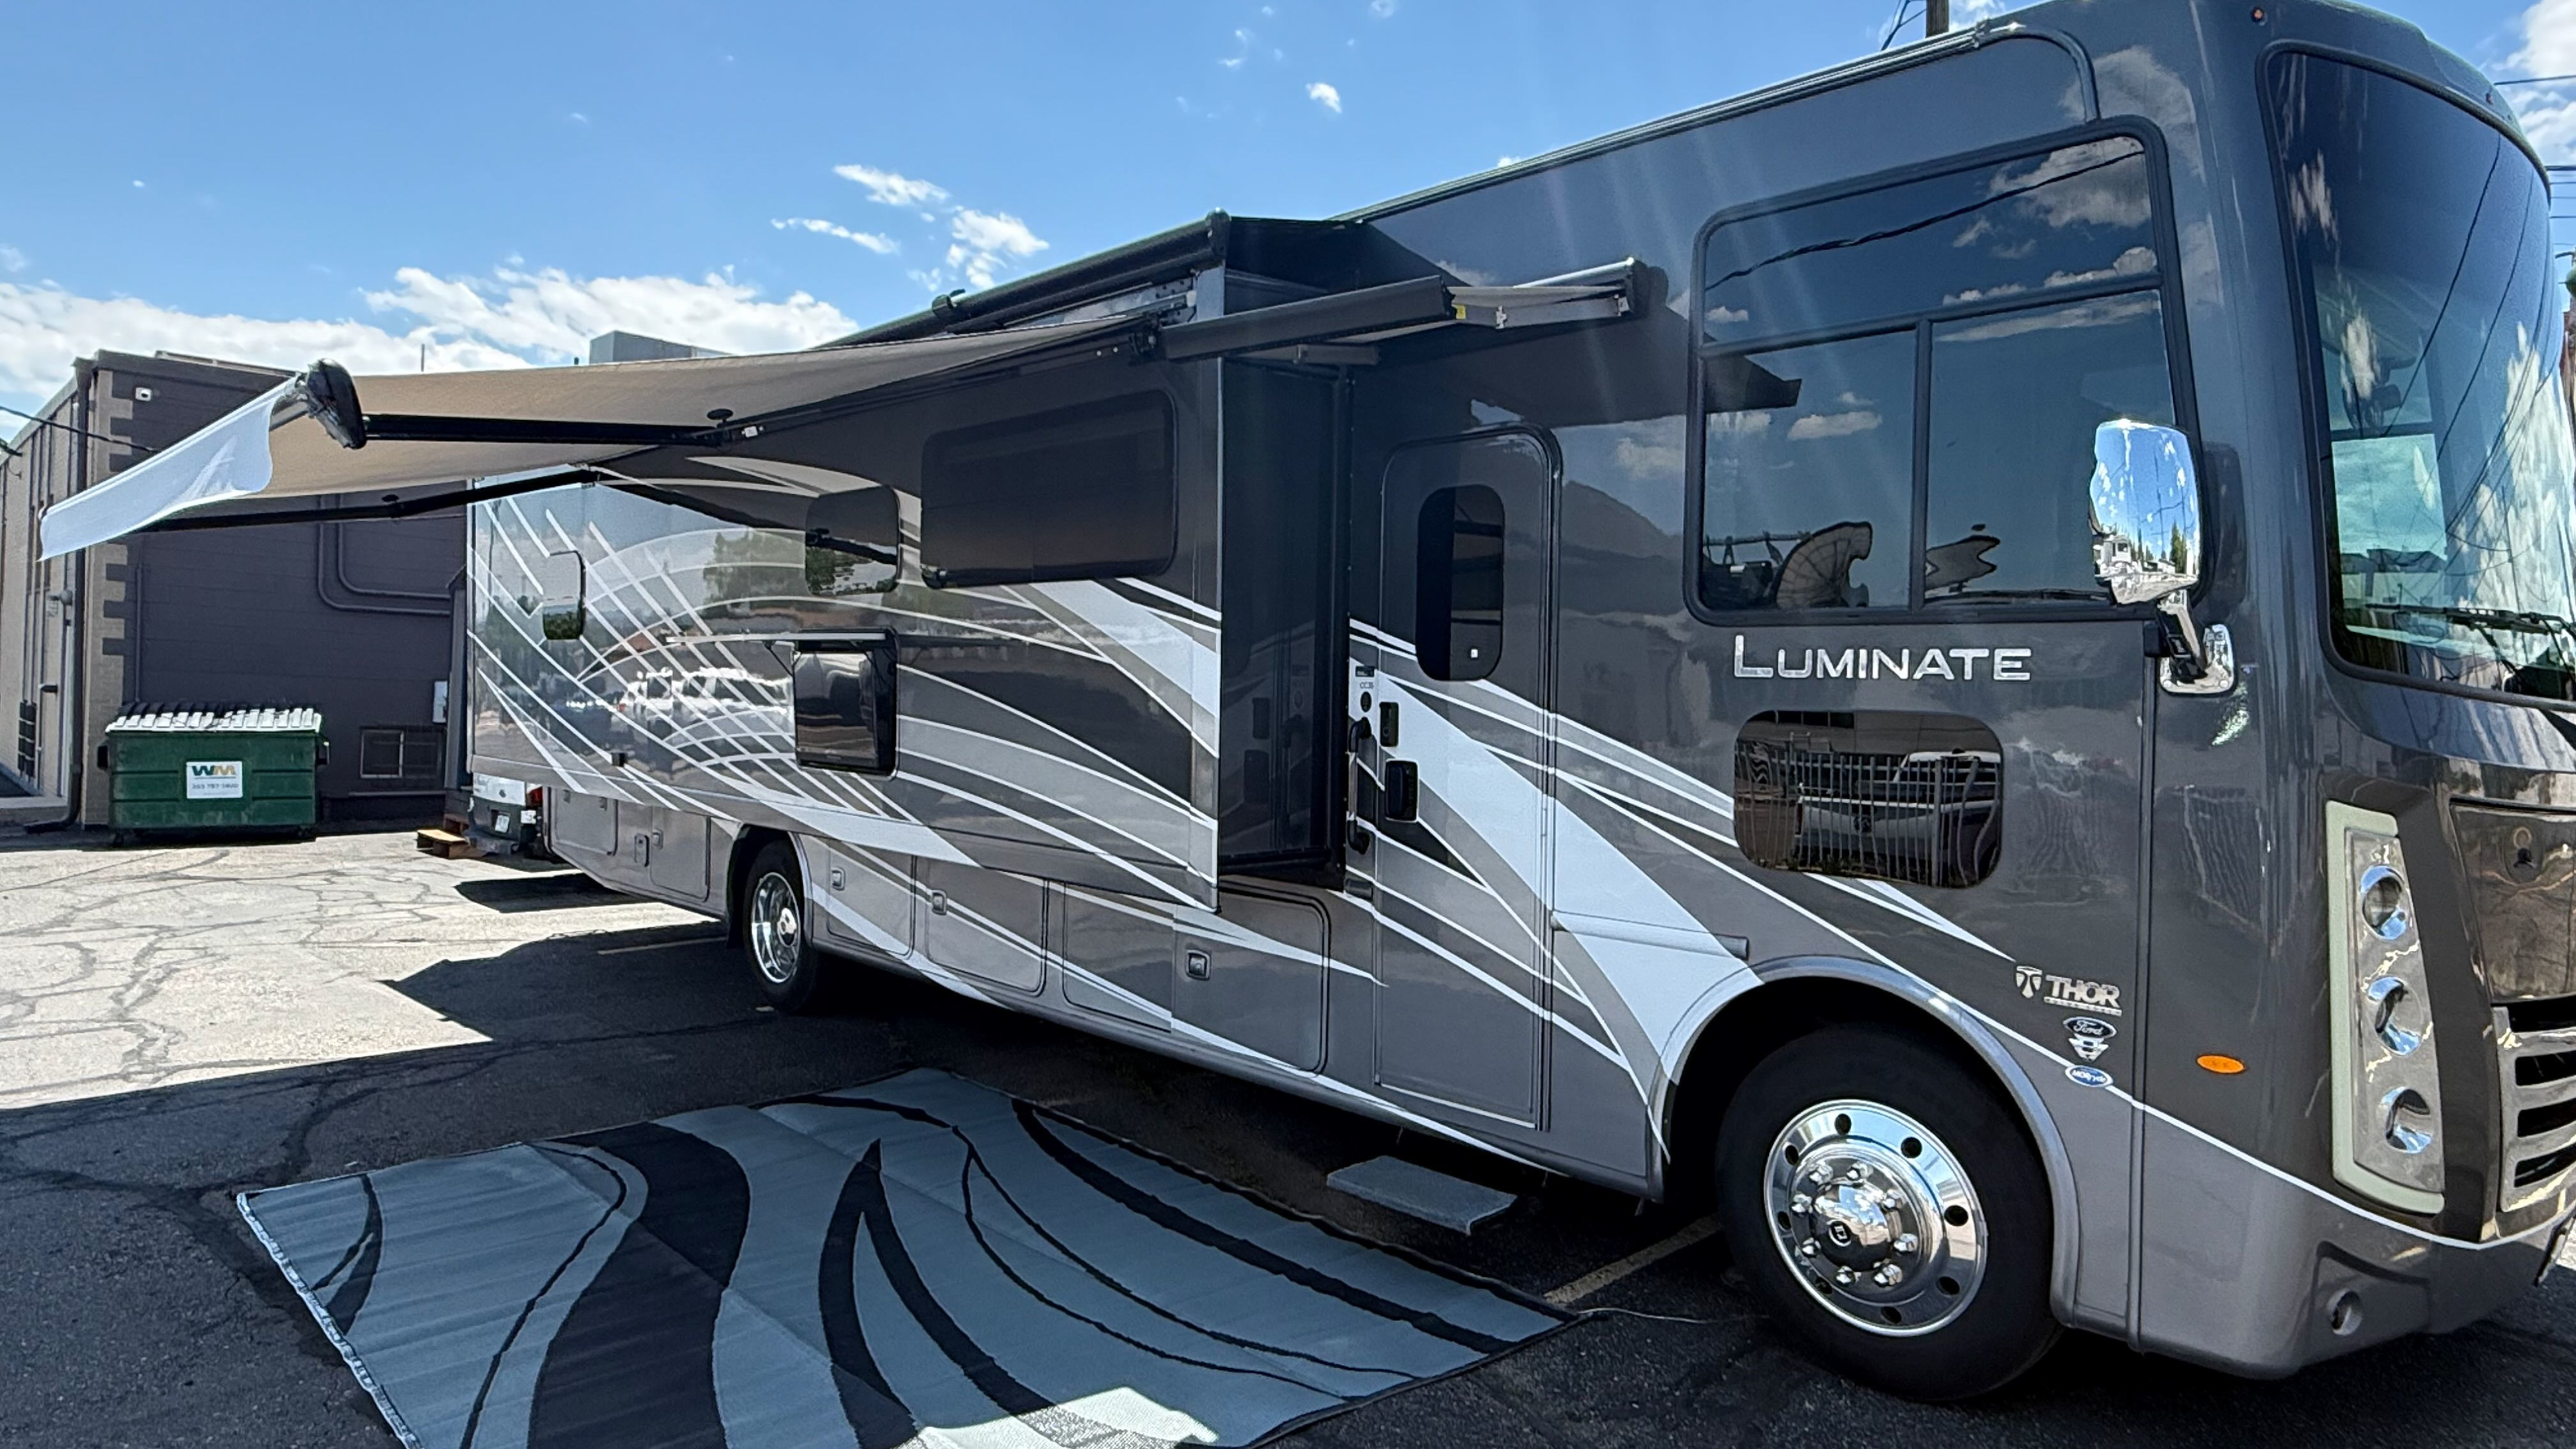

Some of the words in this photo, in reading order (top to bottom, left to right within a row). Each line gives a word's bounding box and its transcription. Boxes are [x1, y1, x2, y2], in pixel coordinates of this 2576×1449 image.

[1734, 634, 2032, 681] LUMINATE
[191, 764, 237, 776] WM
[2045, 974, 2121, 1009] THOR
[2073, 1020, 2104, 1036] Ford
